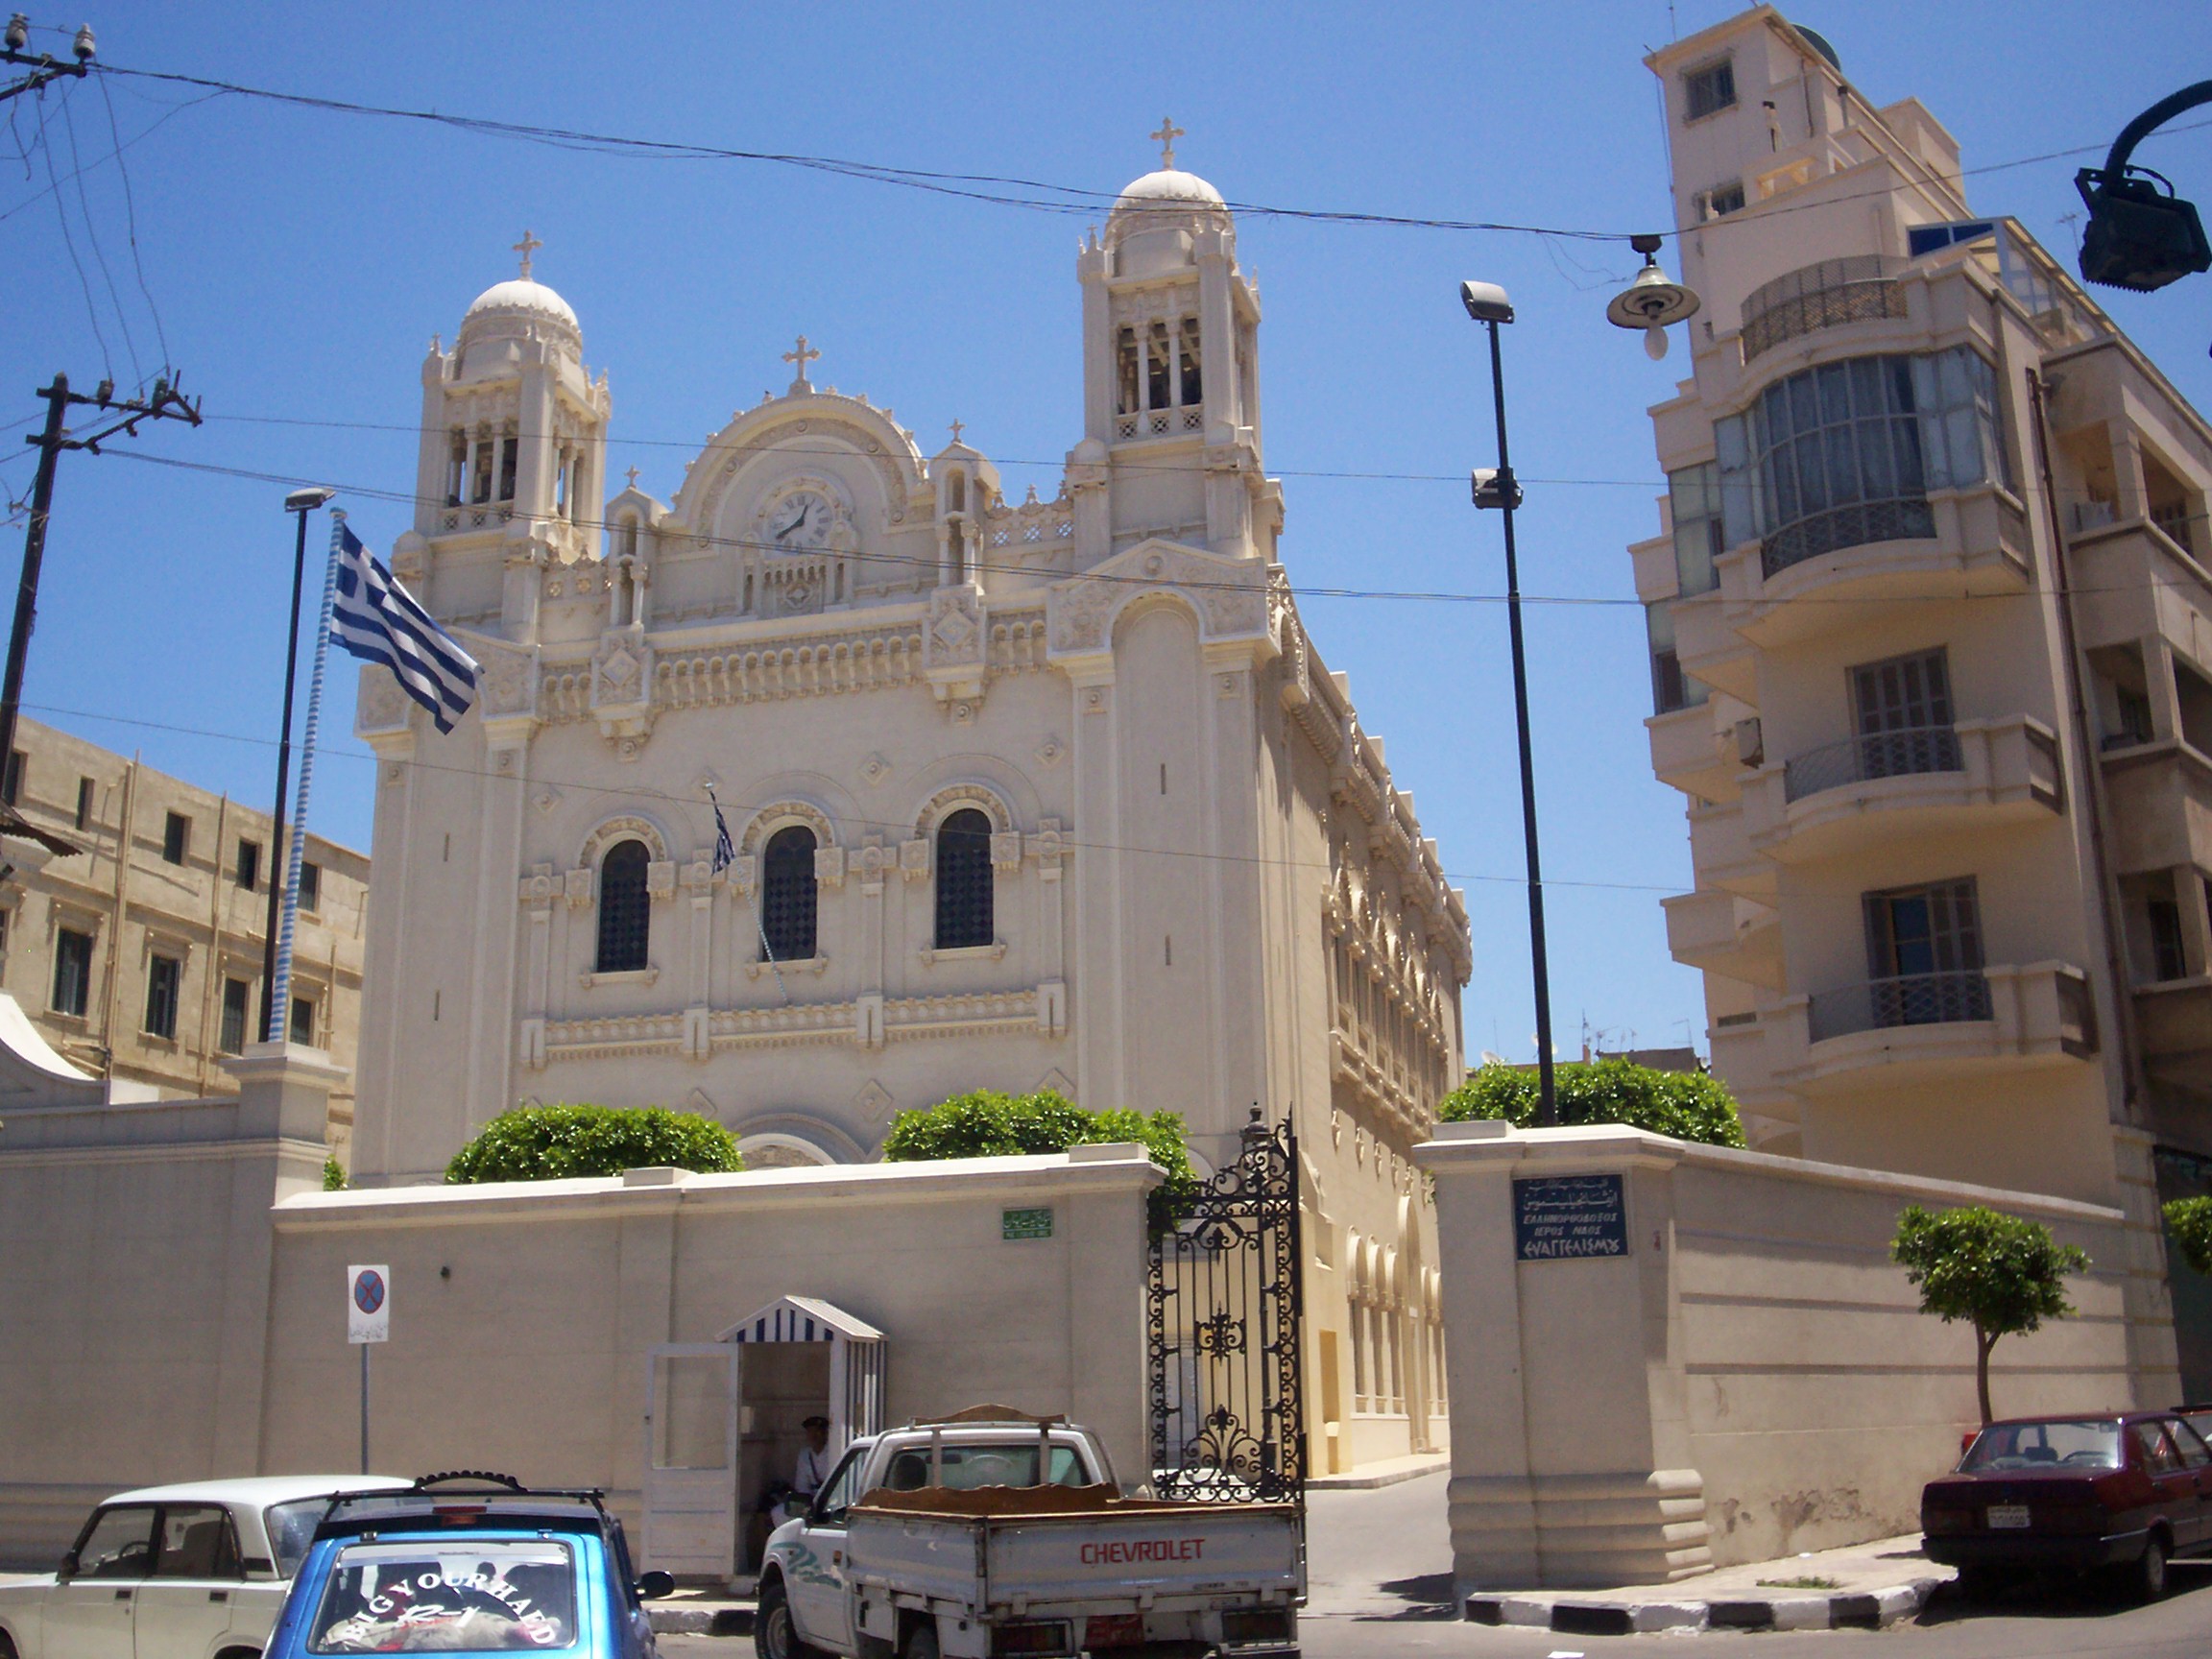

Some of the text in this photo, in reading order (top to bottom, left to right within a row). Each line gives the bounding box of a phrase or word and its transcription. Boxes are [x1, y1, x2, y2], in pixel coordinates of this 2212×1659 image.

[1080, 1539, 1205, 1564] CHEVROLET
[341, 1594, 395, 1643] BIG
[389, 1572, 488, 1598] YOUR
